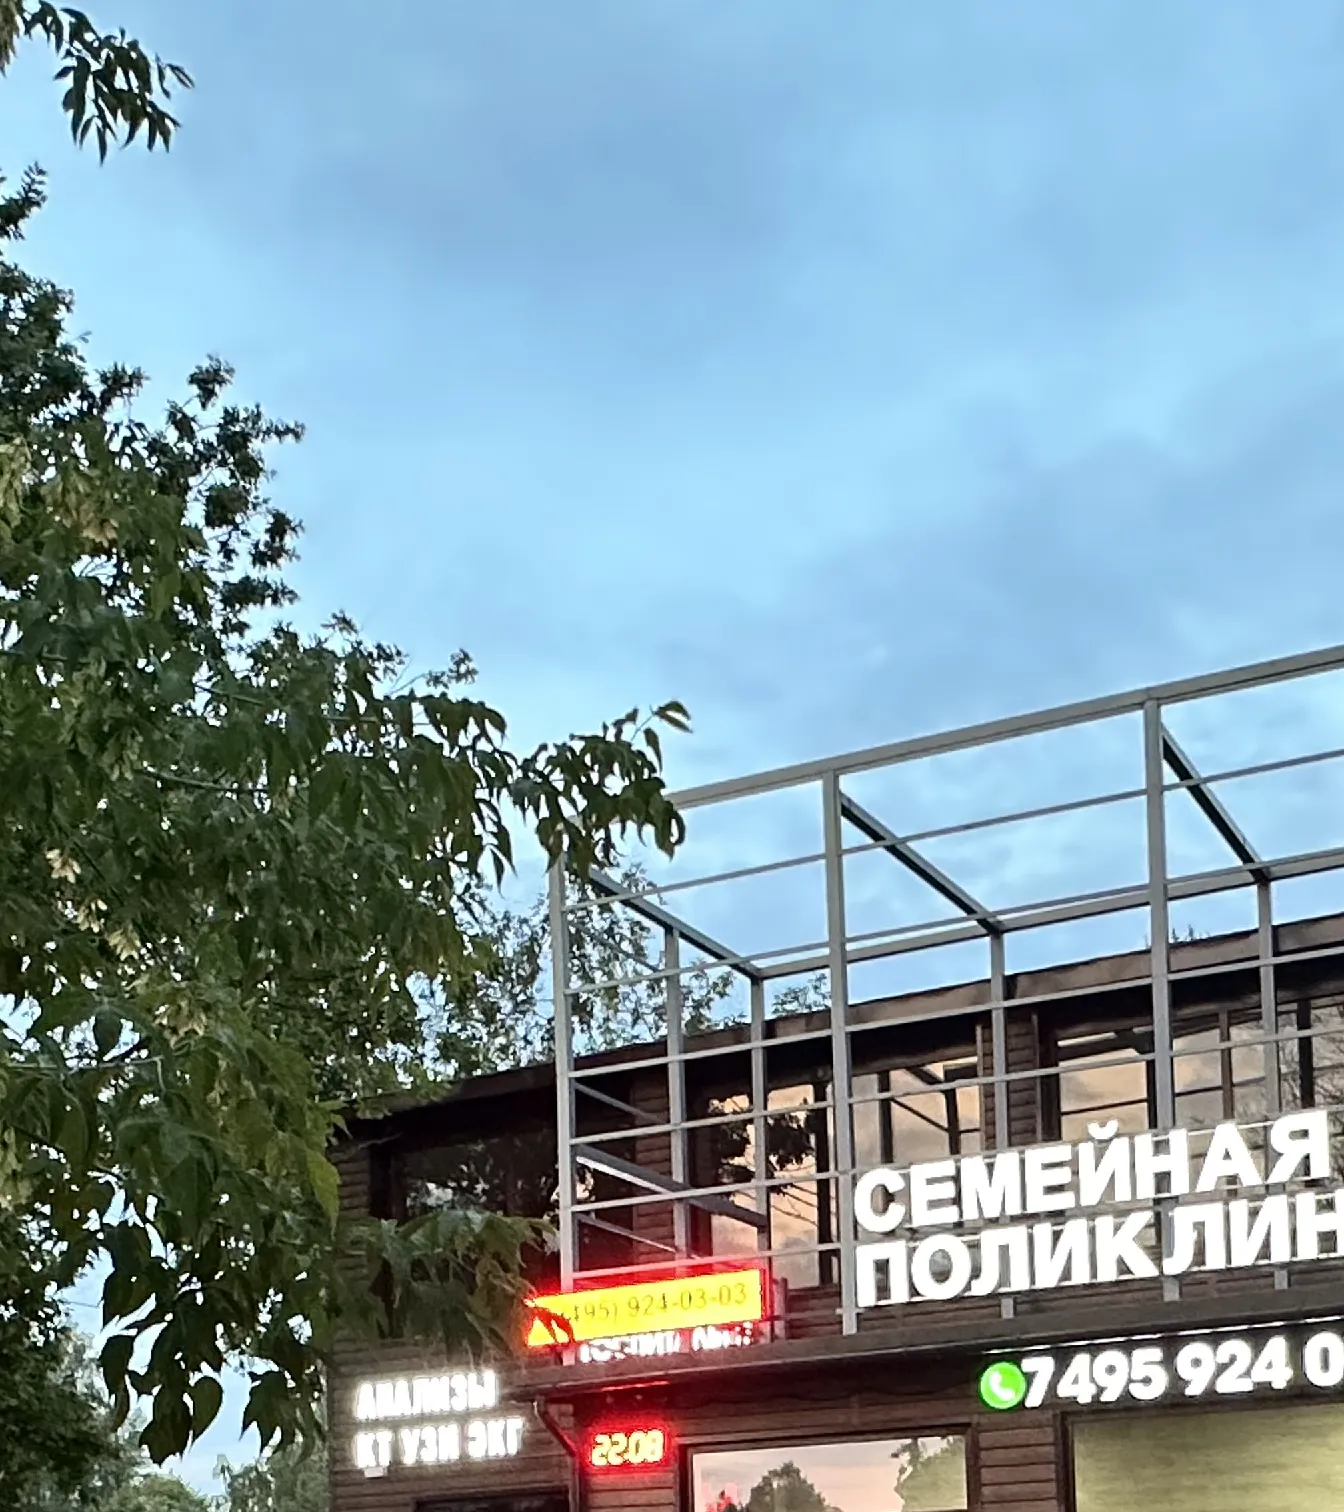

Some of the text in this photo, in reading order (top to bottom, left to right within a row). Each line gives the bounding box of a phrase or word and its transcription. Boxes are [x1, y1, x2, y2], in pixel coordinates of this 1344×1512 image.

[853, 1109, 1332, 1236] СЕМЕЙНАЯ
[356, 1370, 499, 1421] АНАЛИЗЫ
[1176, 1337, 1294, 1398] 924
[400, 1422, 461, 1466] УЗИ
[467, 1416, 524, 1459] ЭКГ
